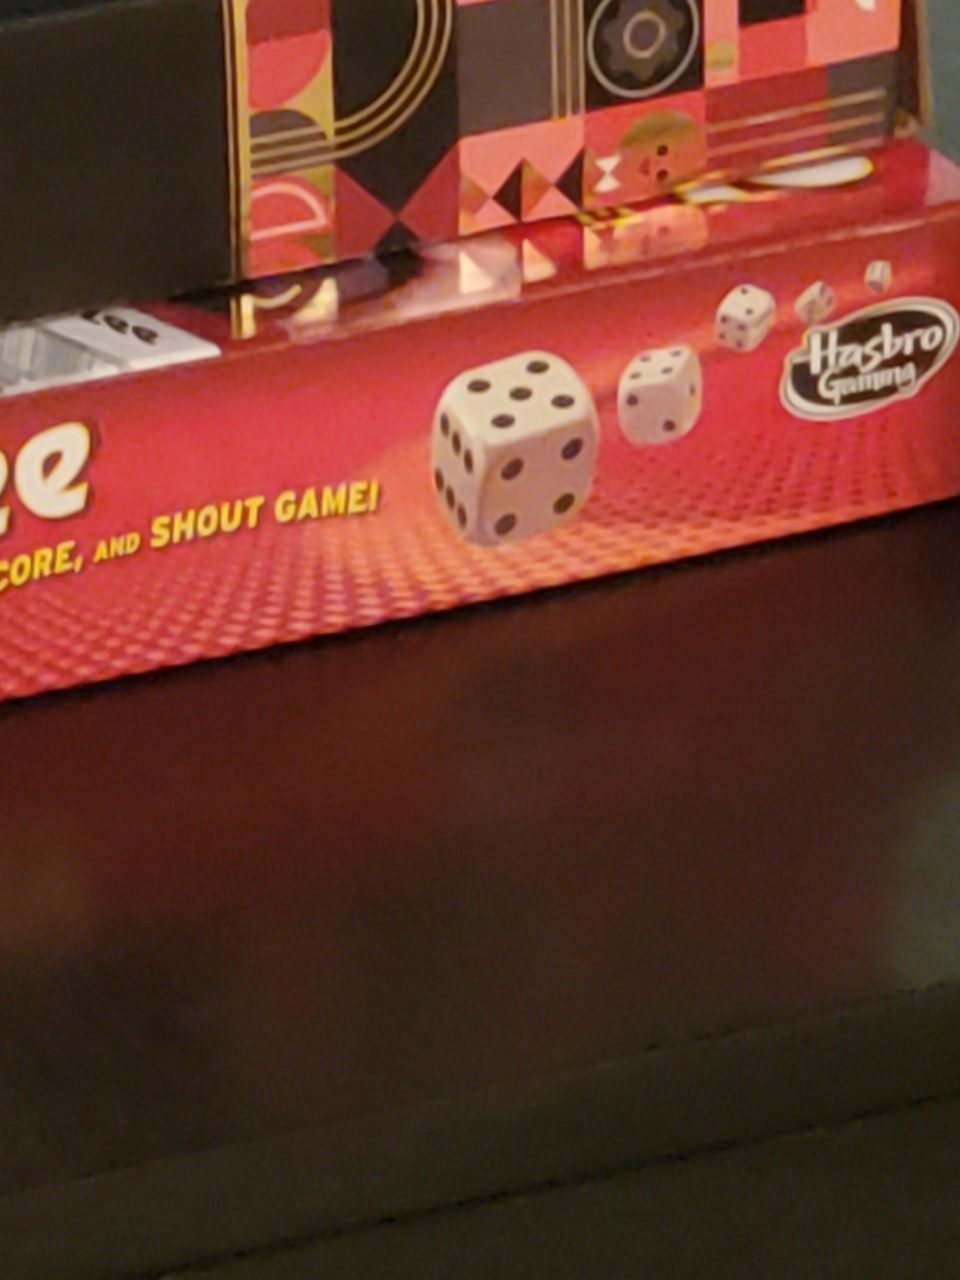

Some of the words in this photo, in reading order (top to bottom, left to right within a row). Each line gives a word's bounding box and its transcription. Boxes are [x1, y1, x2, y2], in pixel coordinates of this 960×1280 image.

[808, 320, 944, 376] Hasbro
[816, 362, 917, 406] Gaming
[92, 531, 142, 564] AND
[150, 495, 265, 549] SHOUT
[274, 479, 381, 524] GAME!
